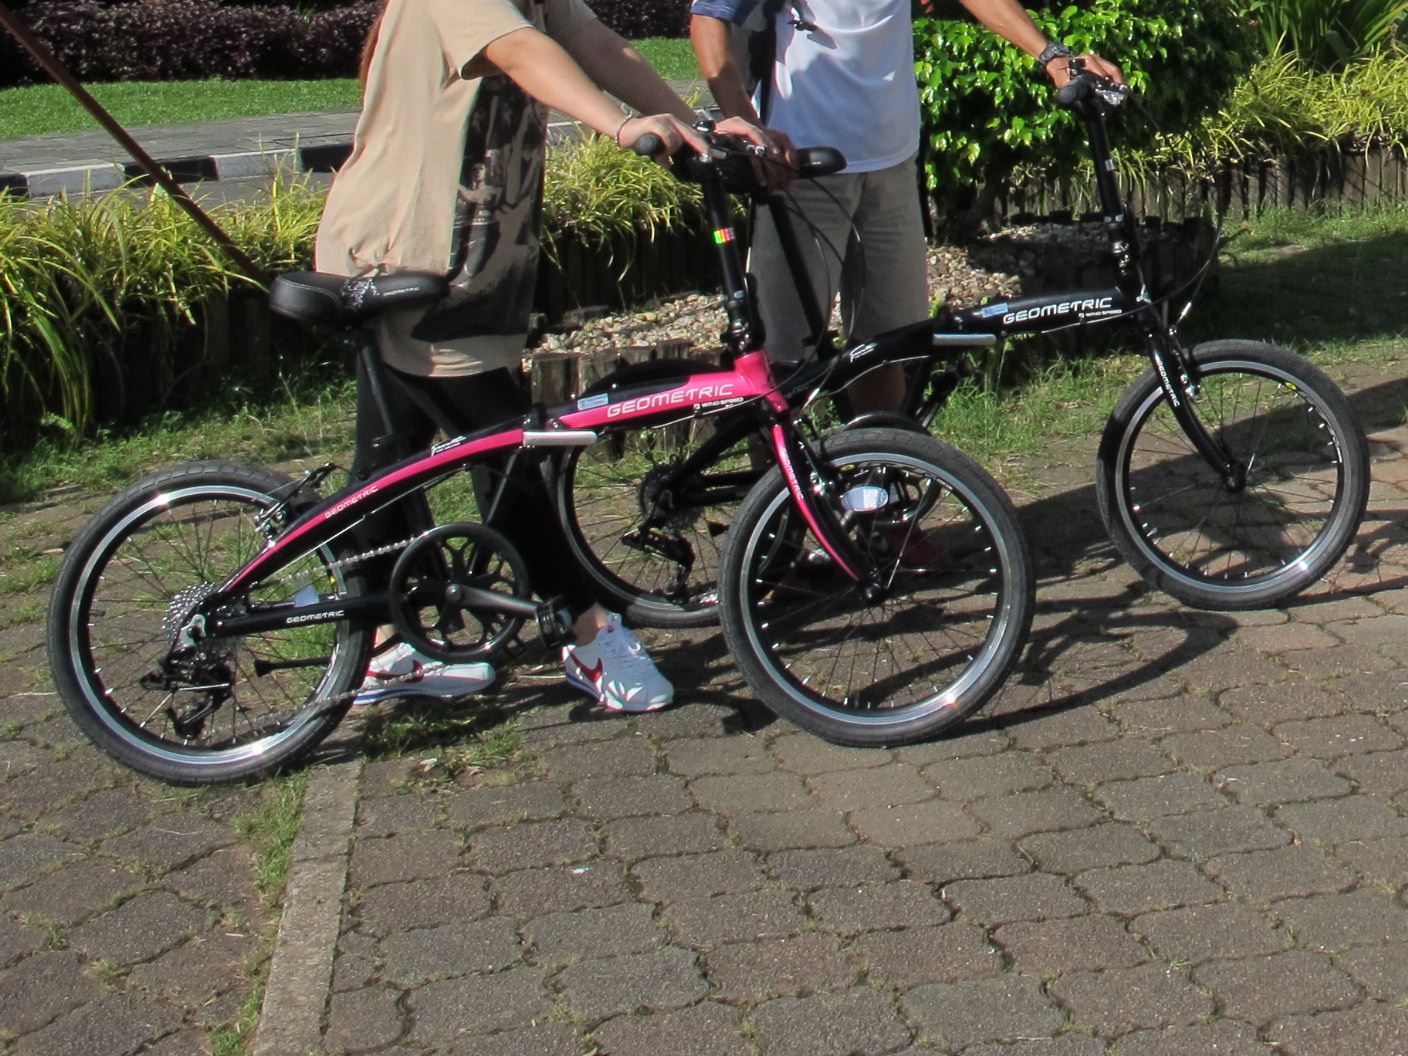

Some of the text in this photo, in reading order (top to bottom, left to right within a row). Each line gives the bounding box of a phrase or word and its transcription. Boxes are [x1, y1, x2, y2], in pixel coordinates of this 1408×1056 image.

[1003, 297, 1113, 325] GEOMETRIC
[607, 383, 735, 419] GEOMETRIC
[324, 485, 379, 519] GEOMETRIC
[286, 609, 345, 624] GEOMETRIC
